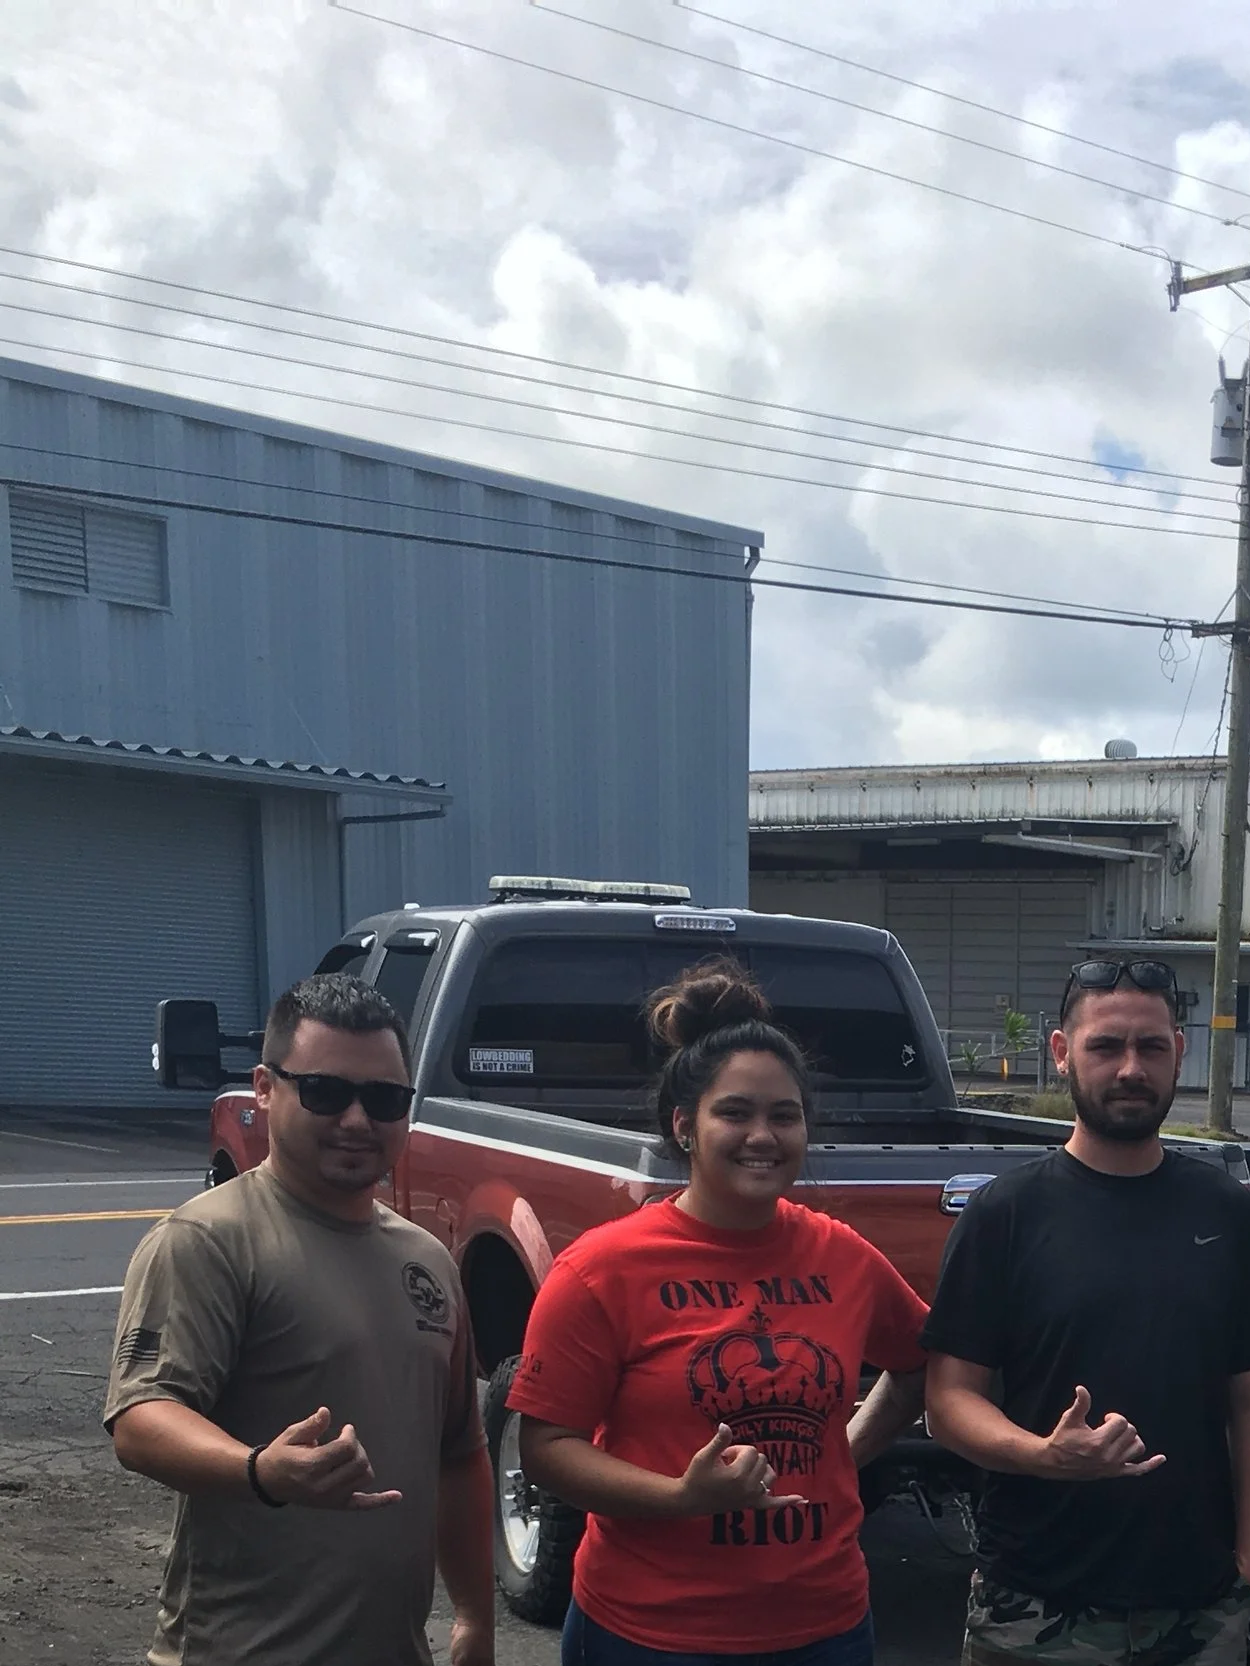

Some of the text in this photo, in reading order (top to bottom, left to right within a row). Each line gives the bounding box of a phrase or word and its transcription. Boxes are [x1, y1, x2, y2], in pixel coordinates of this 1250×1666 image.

[472, 1050, 531, 1062] LOWBEDDING
[472, 1062, 532, 1072] IS NOT A CRIME
[659, 1275, 833, 1311] ONE MAN
[769, 1419, 816, 1437] KINGS
[708, 1502, 829, 1546] RIOT
